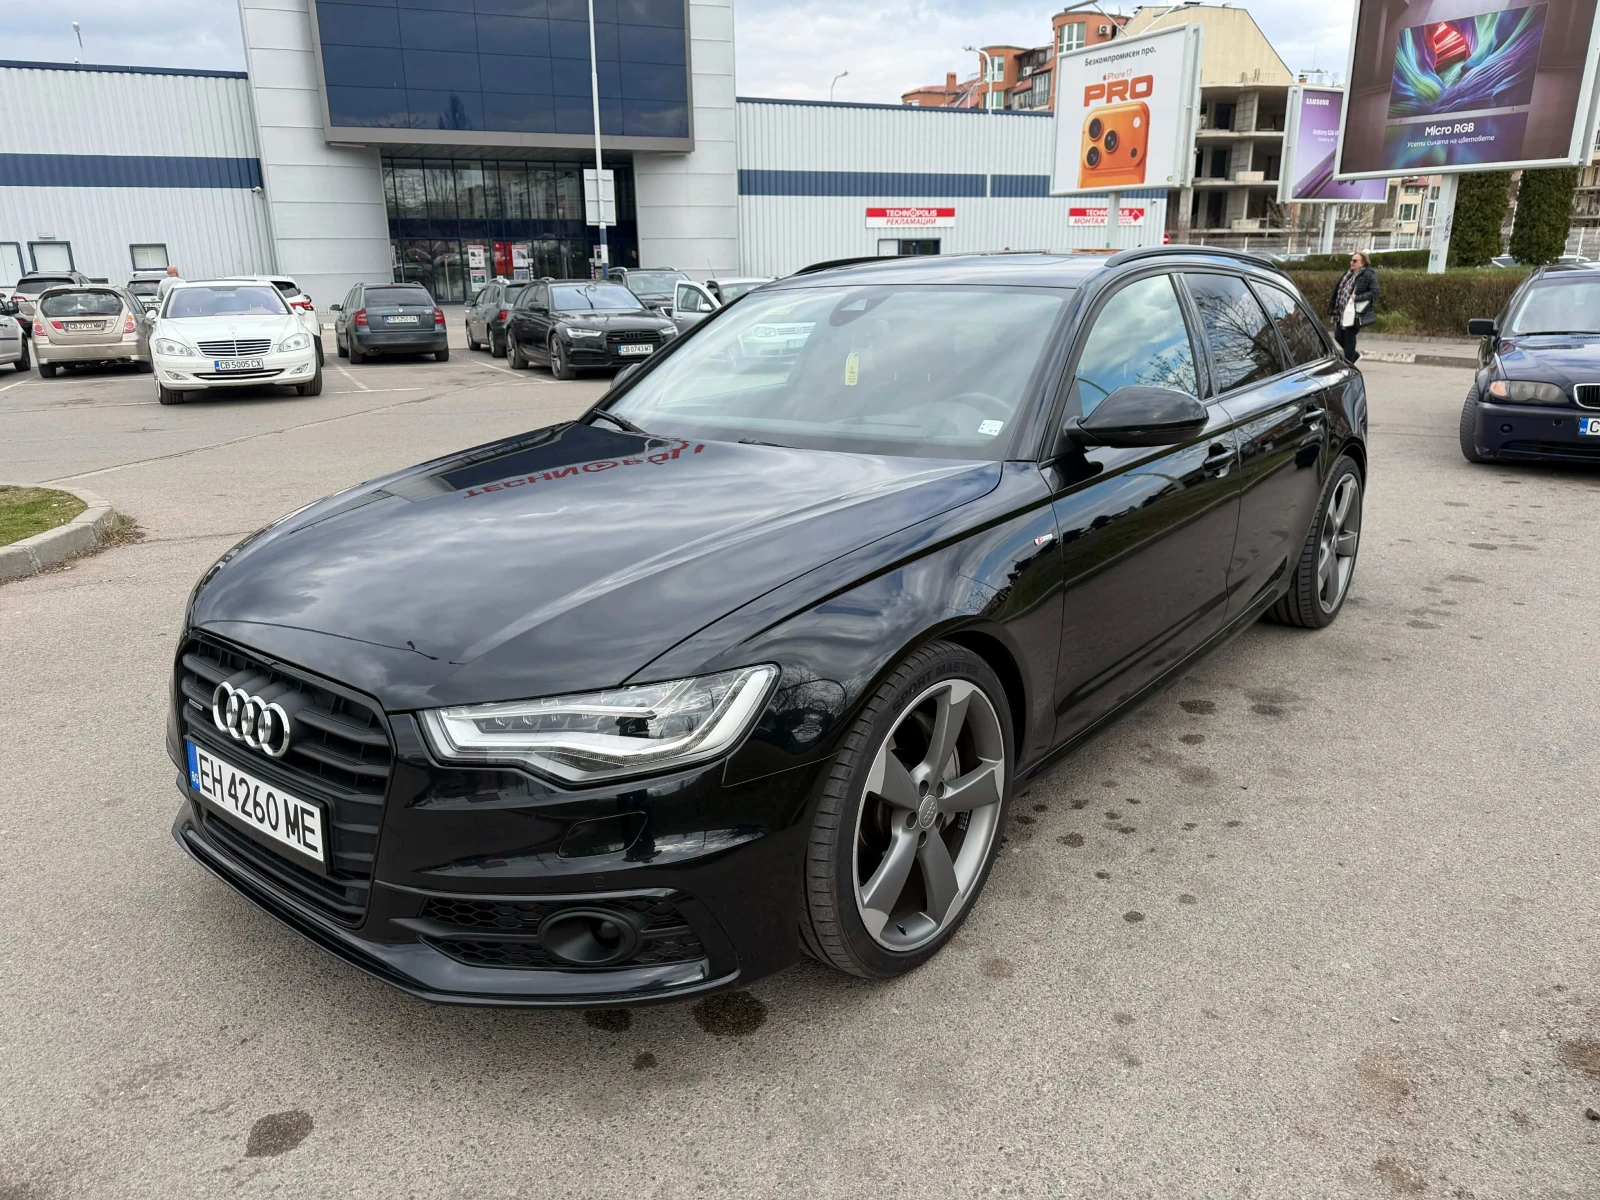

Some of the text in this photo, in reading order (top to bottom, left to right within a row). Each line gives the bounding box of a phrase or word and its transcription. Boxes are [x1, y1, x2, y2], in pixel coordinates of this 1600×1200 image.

[1084, 46, 1156, 67] Безкомпромисен про.
[1107, 68, 1133, 80] iPhone 17
[1084, 74, 1154, 108] PRO
[1306, 97, 1330, 106] SAMSUNG
[1424, 122, 1475, 136] Micro RGB
[1458, 135, 1495, 144] цветовете
[885, 208, 937, 218] TECHNOPOLIS
[220, 360, 262, 369] CB 5005 CX
[892, 661, 980, 714] SPORT MASTER
[191, 771, 199, 785] BG
[198, 752, 318, 853] EH 4260 ME
